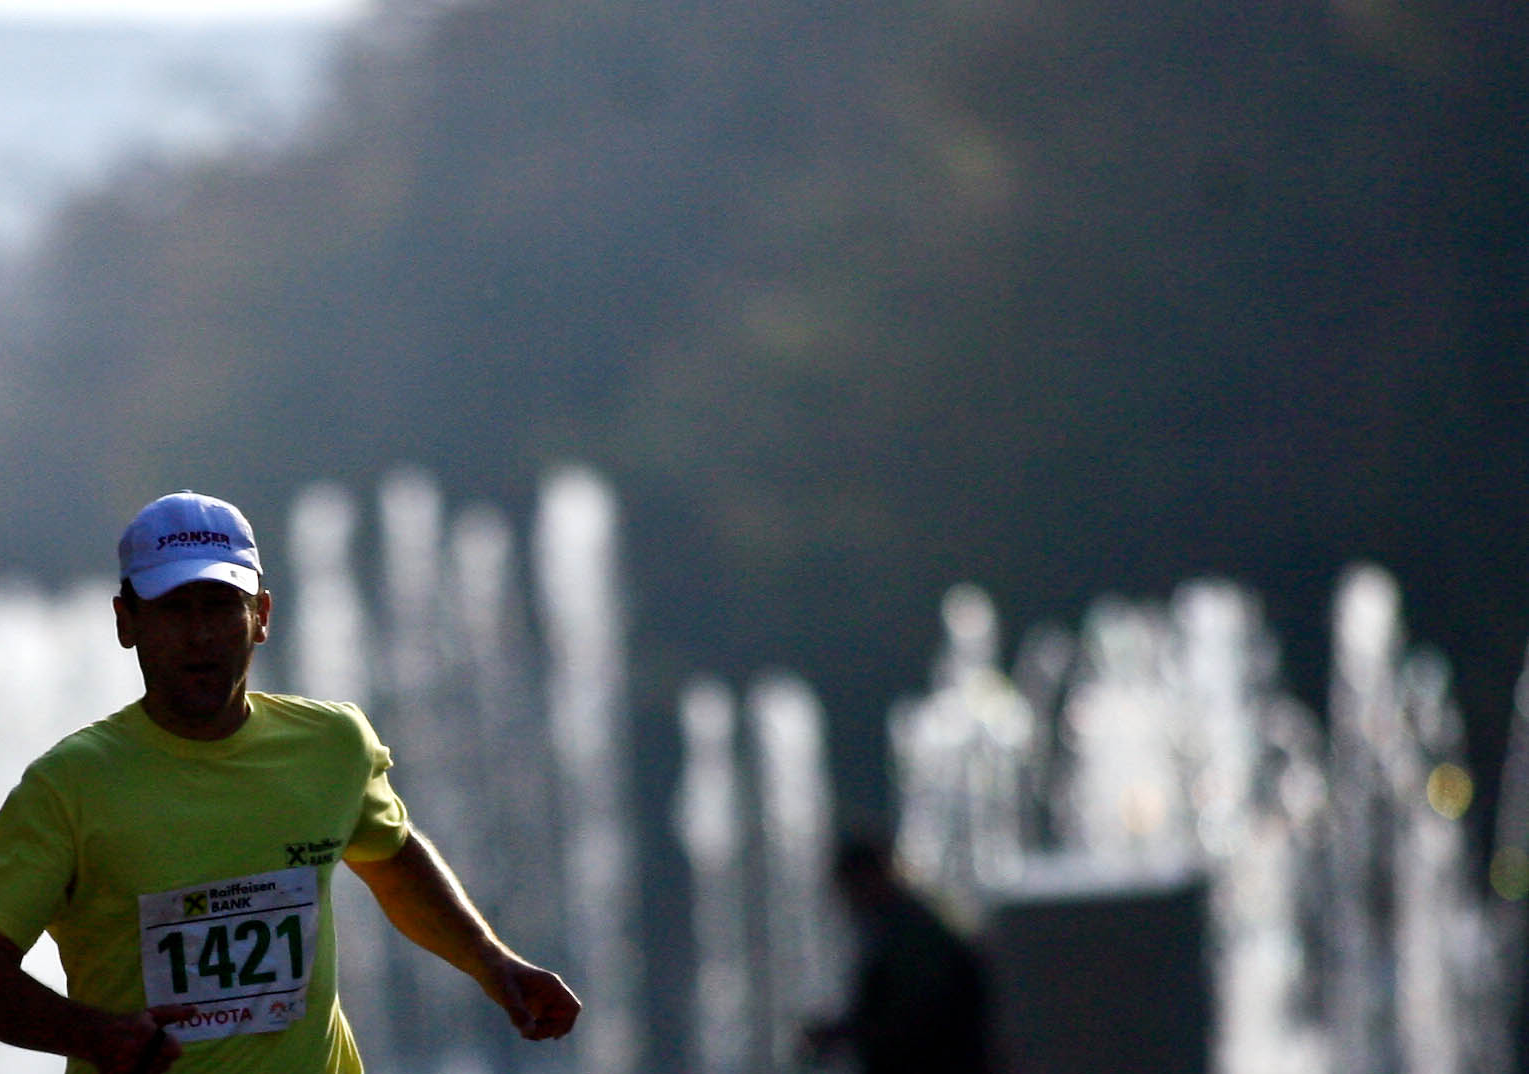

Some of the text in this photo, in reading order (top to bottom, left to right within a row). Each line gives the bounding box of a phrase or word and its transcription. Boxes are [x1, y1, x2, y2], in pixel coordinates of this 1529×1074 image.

[209, 882, 276, 899] Raiffeisen
[211, 897, 251, 913] BANK
[158, 914, 303, 994] 1421
